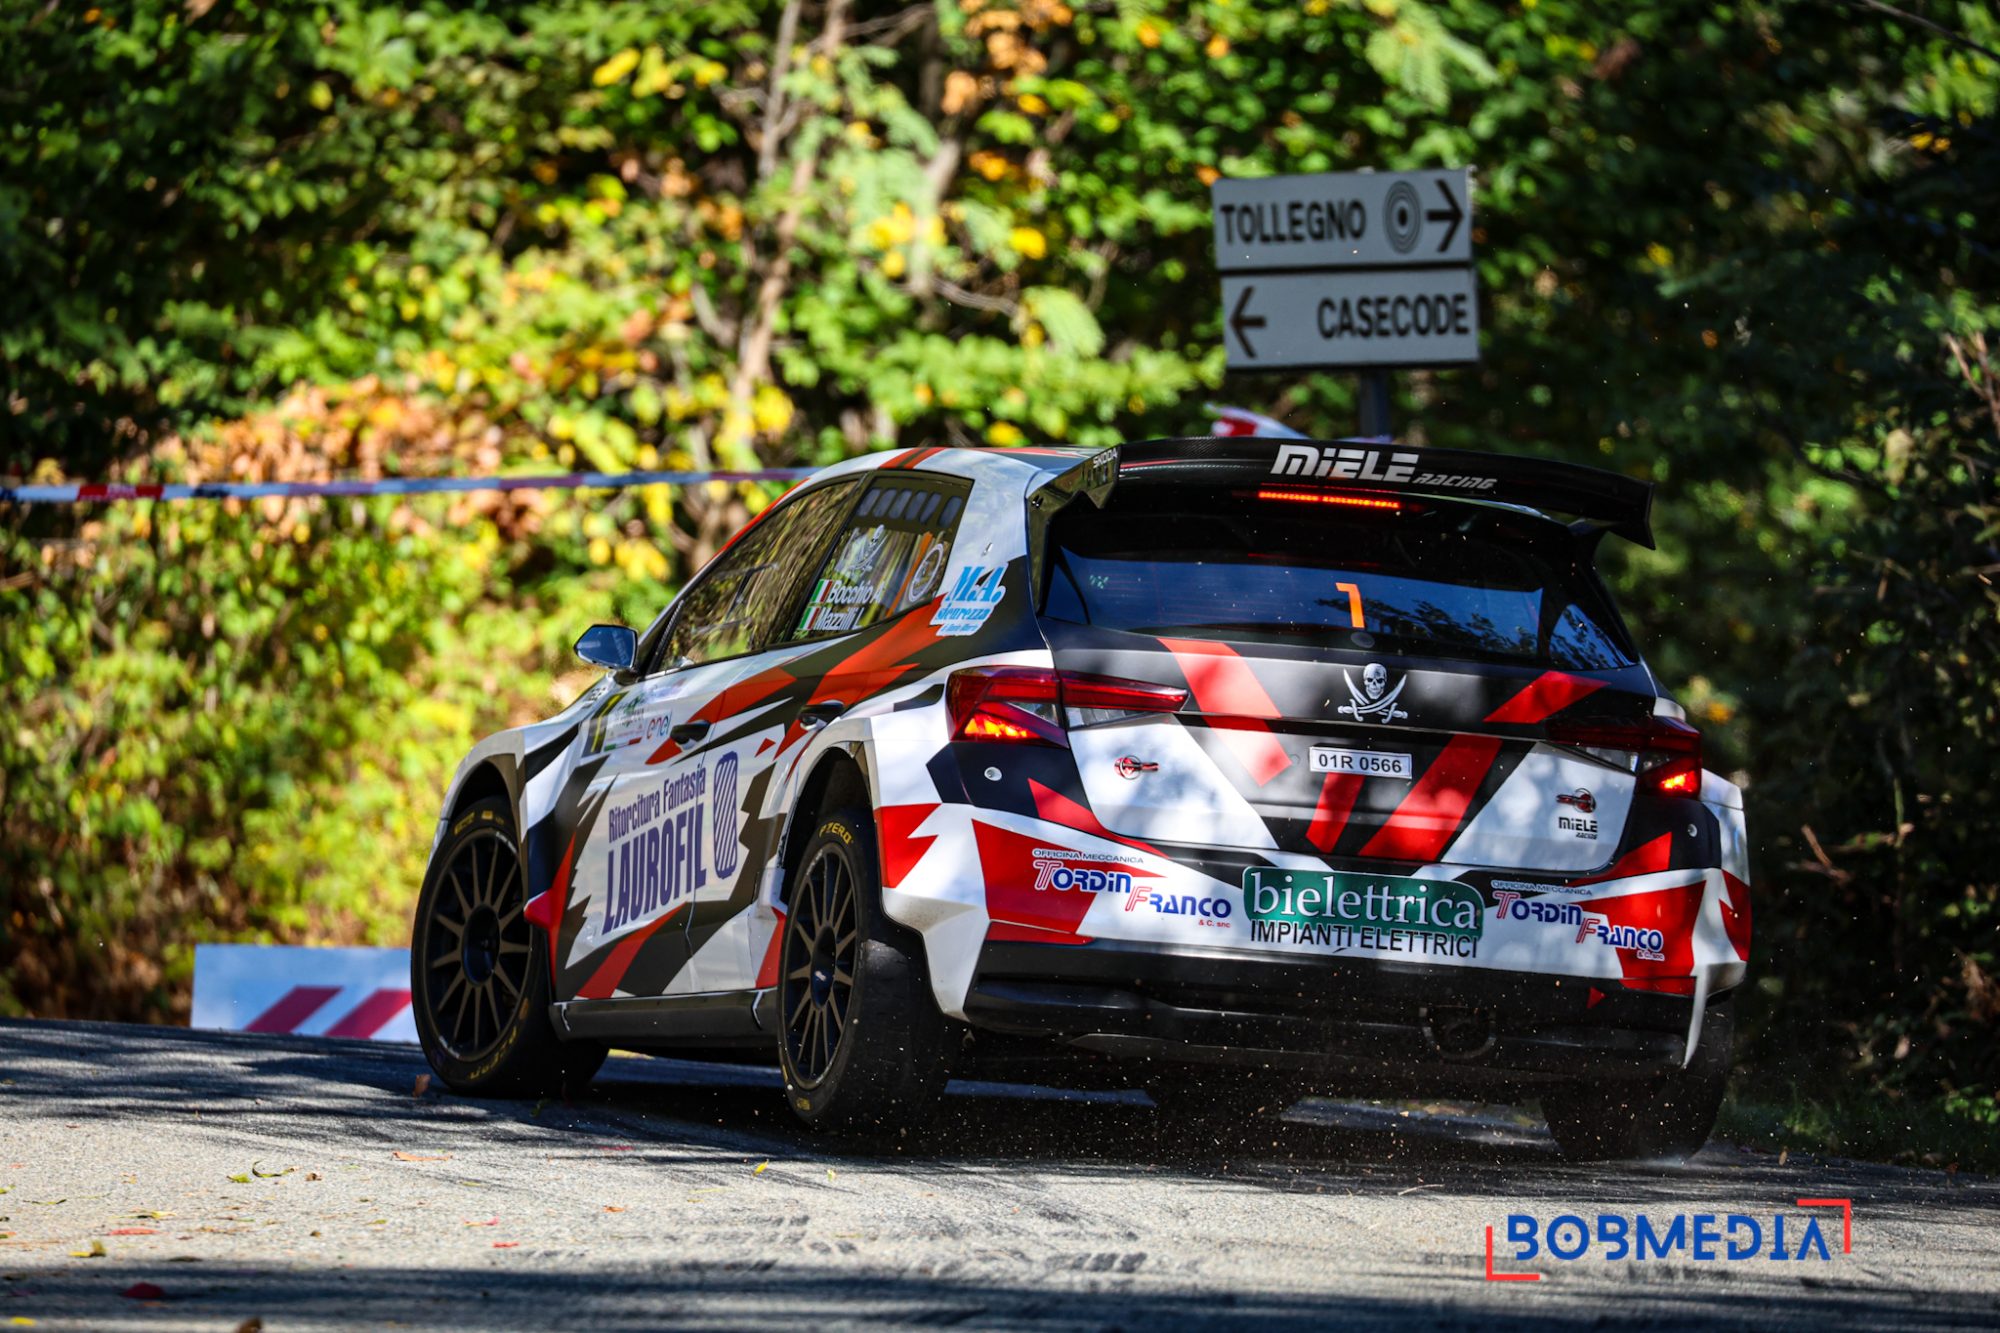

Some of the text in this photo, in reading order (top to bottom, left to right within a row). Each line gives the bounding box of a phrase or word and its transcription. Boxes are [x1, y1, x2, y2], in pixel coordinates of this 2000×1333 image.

[1220, 199, 1366, 244] TOLLEGNO
[1317, 294, 1469, 339] CASECODE
[827, 580, 873, 604] Bocchio
[1318, 754, 1402, 773] 01R 0566
[609, 764, 707, 843] Ritorcitura Fantasia
[602, 802, 707, 936] LAUROFIL
[1033, 850, 1144, 864] OFFICINA MECCANICA
[1251, 872, 1478, 930] bielettrica
[1493, 882, 1593, 896] OFFICINA MECCANICA
[1250, 919, 1478, 959] IMPIANTI ELETTRICI
